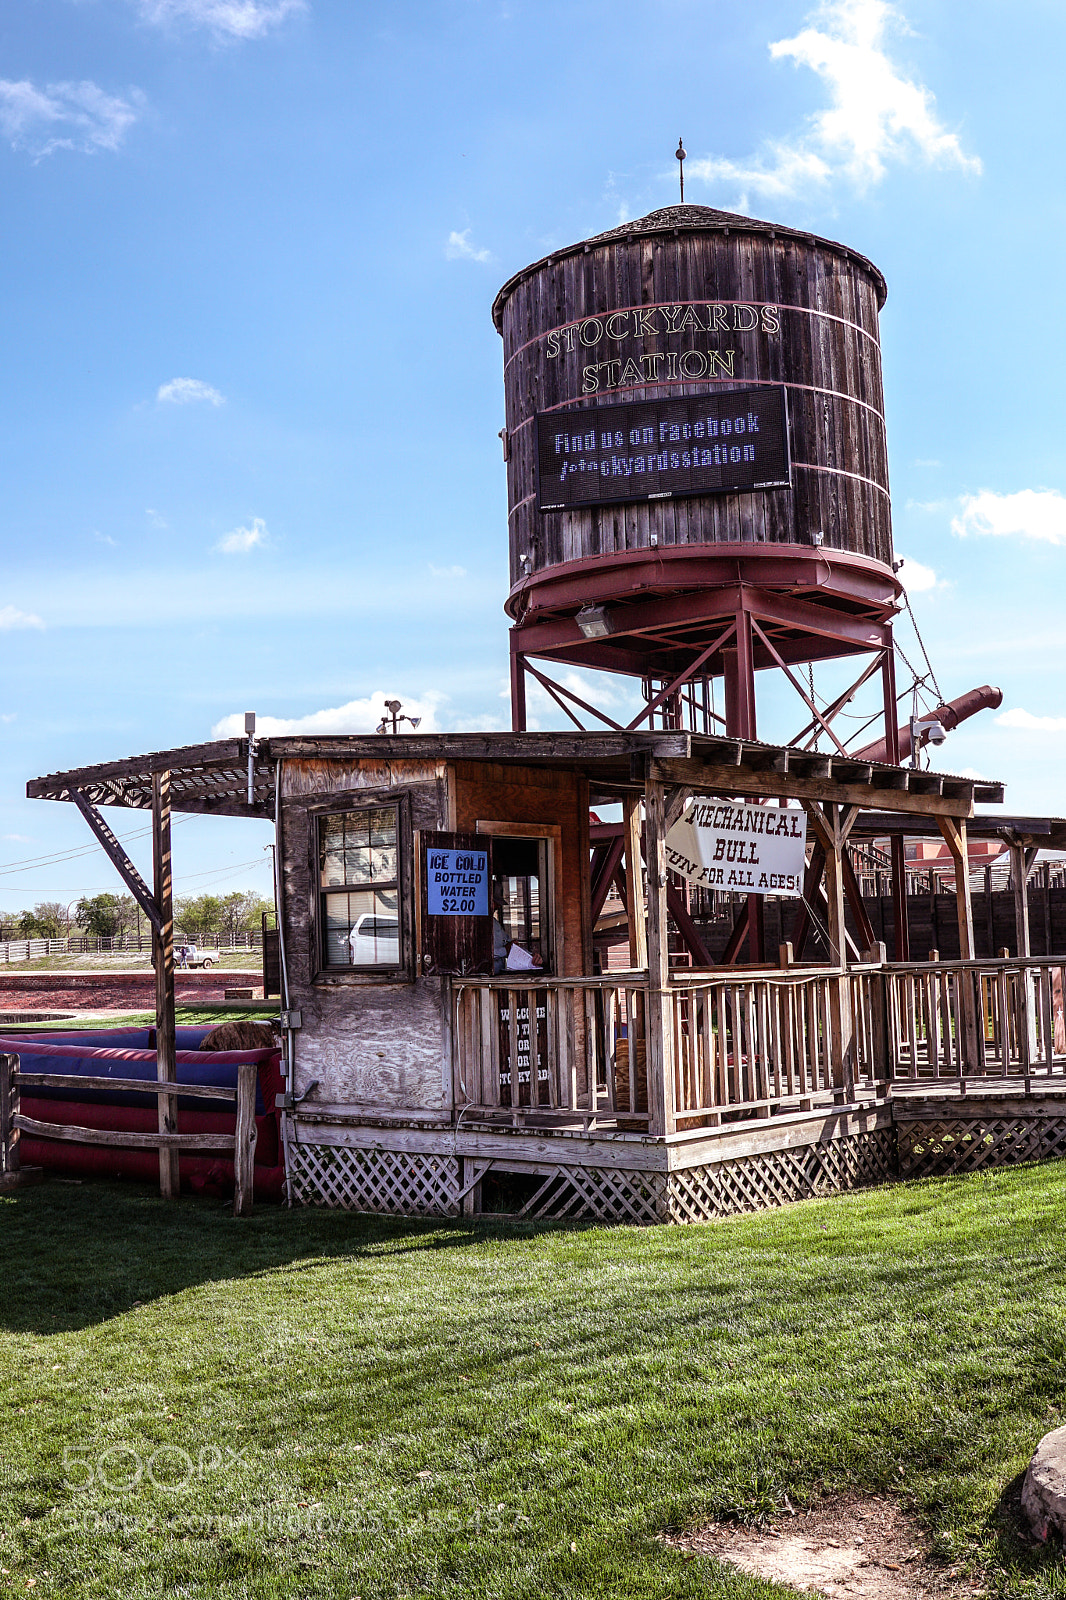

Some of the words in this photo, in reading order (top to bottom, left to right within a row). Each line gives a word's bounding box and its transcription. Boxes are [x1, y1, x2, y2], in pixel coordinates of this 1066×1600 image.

[546, 303, 780, 359] STOCKYARDS
[582, 350, 735, 393] STATION
[555, 430, 596, 453] Find
[601, 431, 624, 448] us
[629, 427, 654, 445] on
[659, 412, 760, 442] Facebook
[684, 803, 803, 839] MECHANICAL
[429, 851, 450, 870] ICE
[455, 853, 486, 872] COLD
[712, 838, 760, 865] BULL
[434, 871, 482, 884] BOTTLED
[697, 867, 724, 884] FOR
[727, 869, 755, 887] ALL
[758, 872, 800, 891] AGES!
[440, 885, 477, 898] WATER
[441, 898, 476, 913] $2.00
